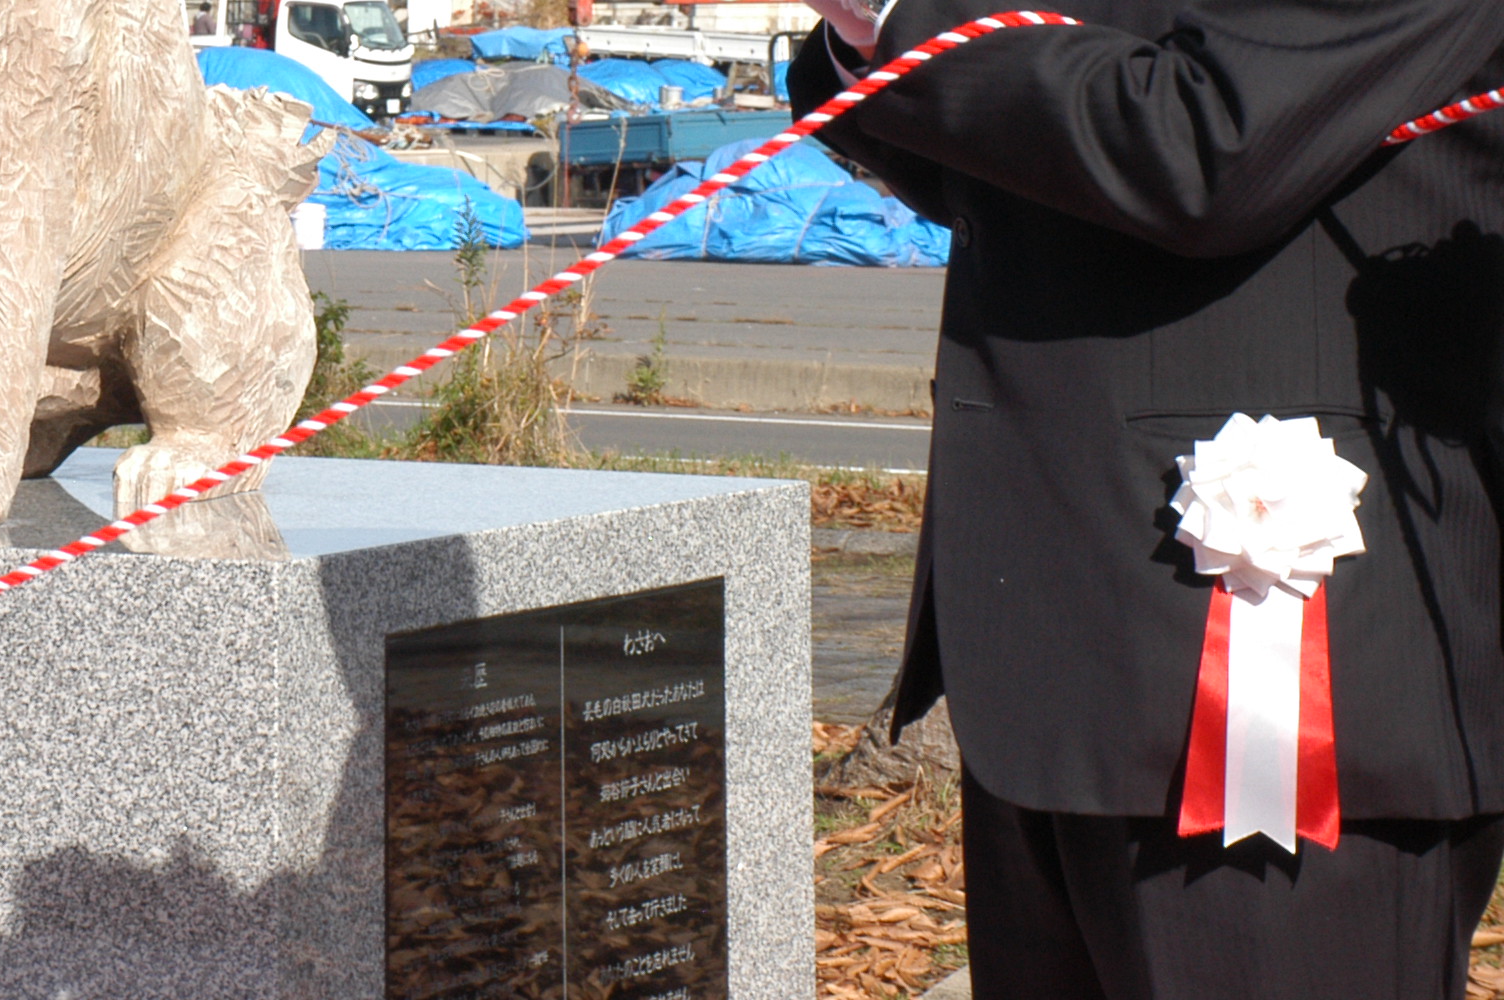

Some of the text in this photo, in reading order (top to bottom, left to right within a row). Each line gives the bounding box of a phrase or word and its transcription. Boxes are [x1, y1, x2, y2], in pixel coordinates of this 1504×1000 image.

[624, 629, 666, 655] わさおへ
[583, 680, 705, 721] 長毛の白秋田犬だったあなたは
[600, 766, 690, 802] 菊谷節子さんと出会い
[590, 804, 700, 848] あっという間に人気者になって
[606, 893, 687, 930] そして去って行きました
